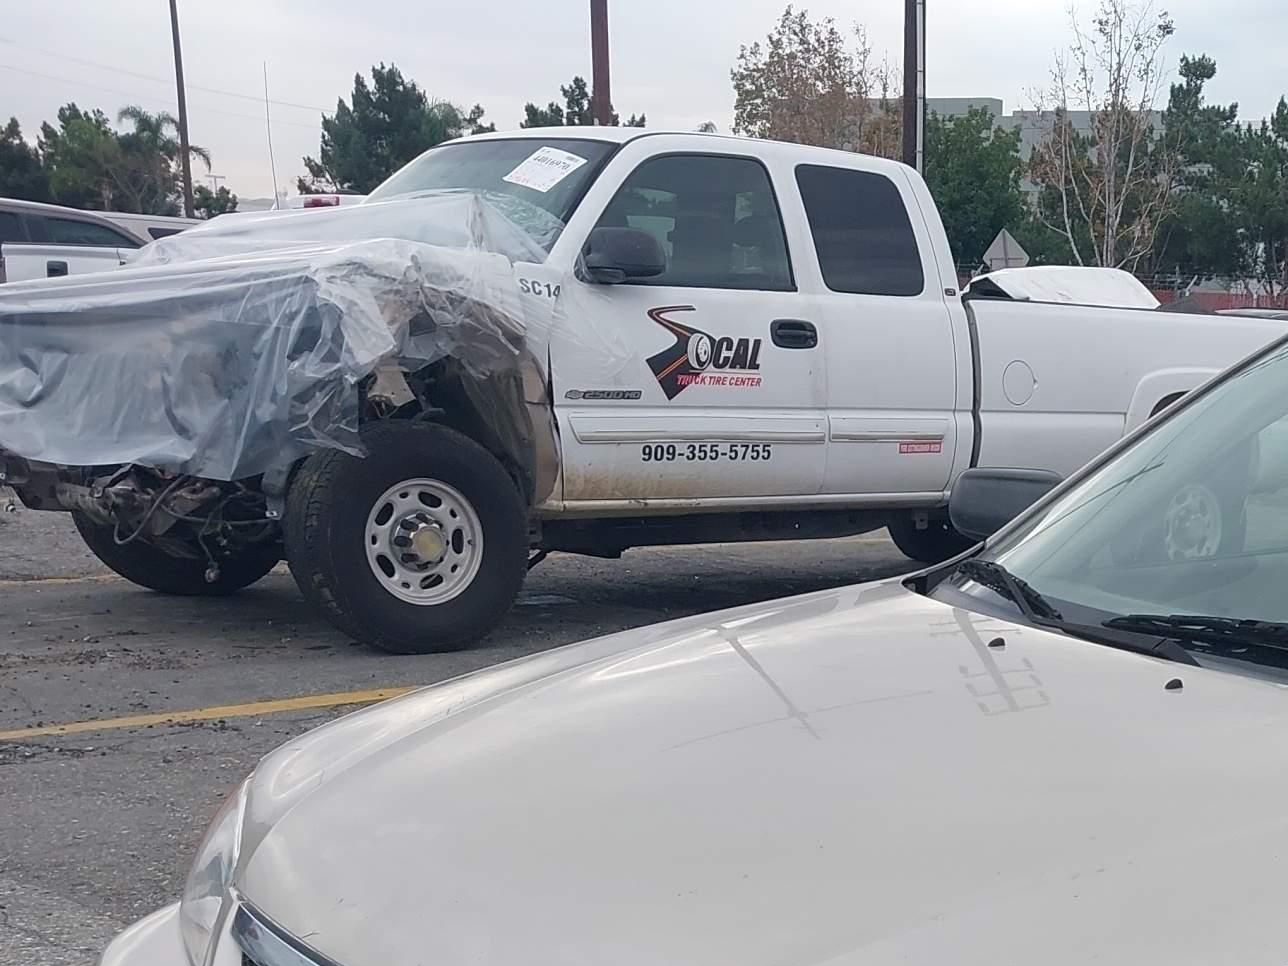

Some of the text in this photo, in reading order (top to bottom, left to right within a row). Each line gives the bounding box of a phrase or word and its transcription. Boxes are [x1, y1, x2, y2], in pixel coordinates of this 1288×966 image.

[676, 374, 762, 387] TRUCK TIRE CENTER
[641, 444, 772, 461] 909-355-5755
